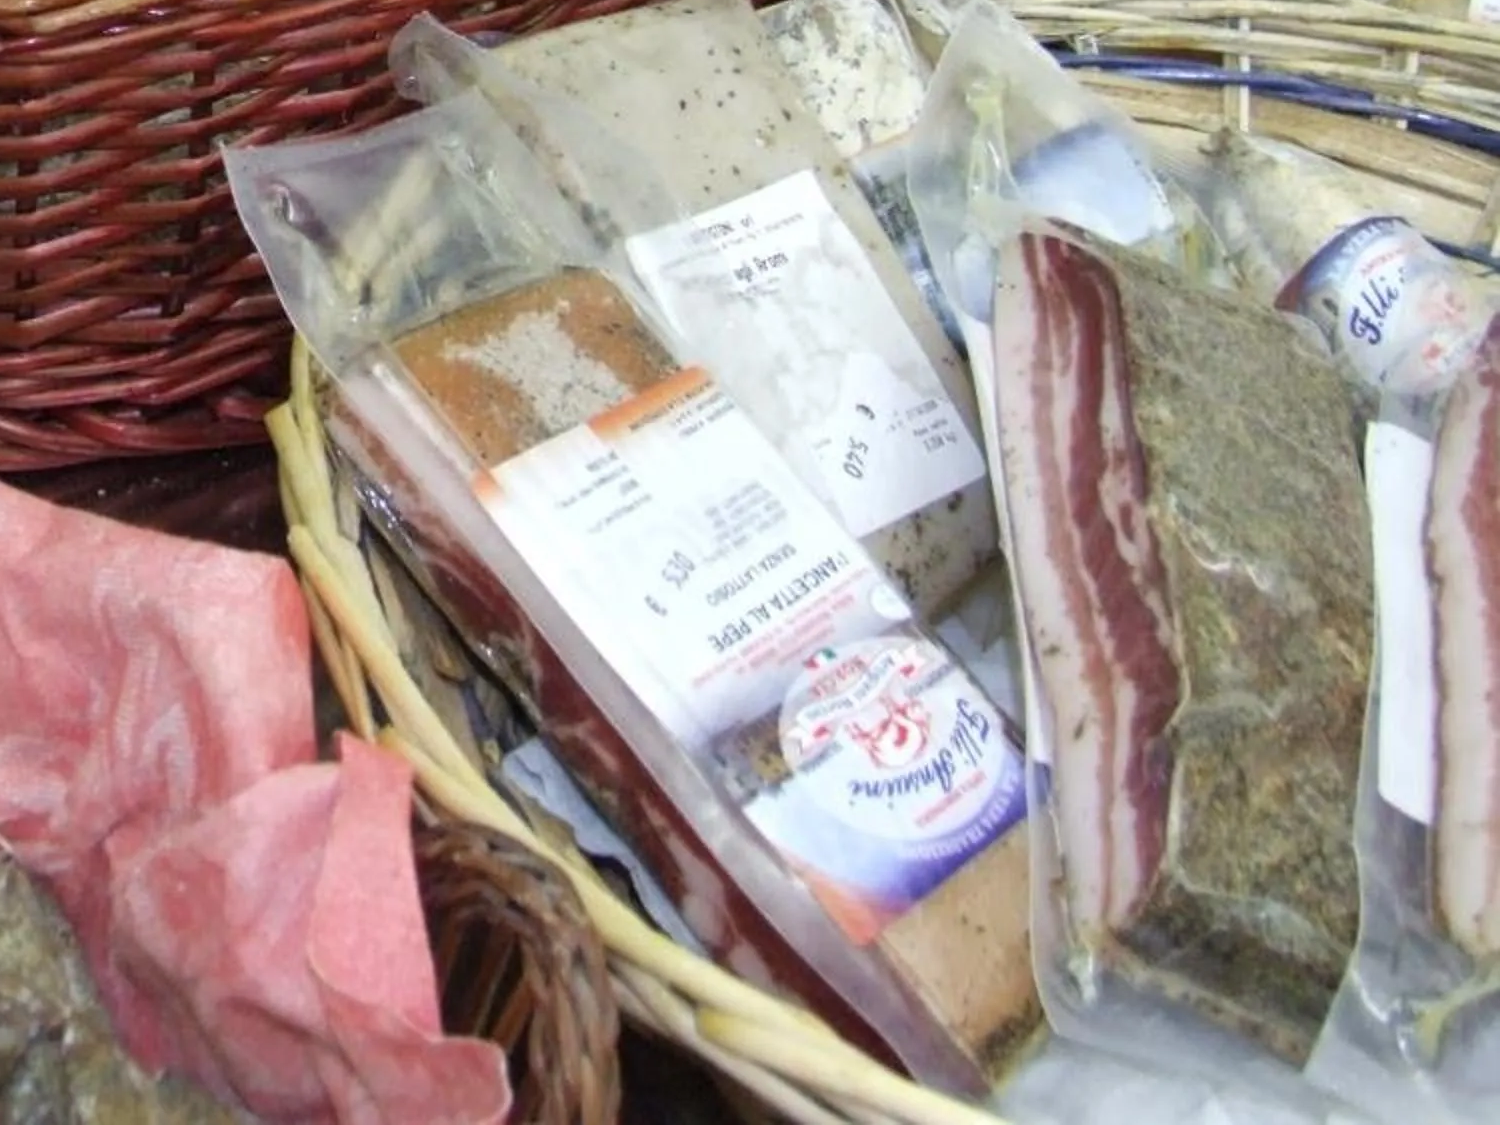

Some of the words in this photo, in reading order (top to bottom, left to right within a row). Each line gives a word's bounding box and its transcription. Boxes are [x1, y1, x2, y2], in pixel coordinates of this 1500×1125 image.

[1349, 275, 1397, 344] F.lli
[756, 540, 798, 574] SENZA
[746, 601, 773, 628] AL
[705, 615, 753, 656] PEPE
[846, 750, 955, 810] Ansuini
